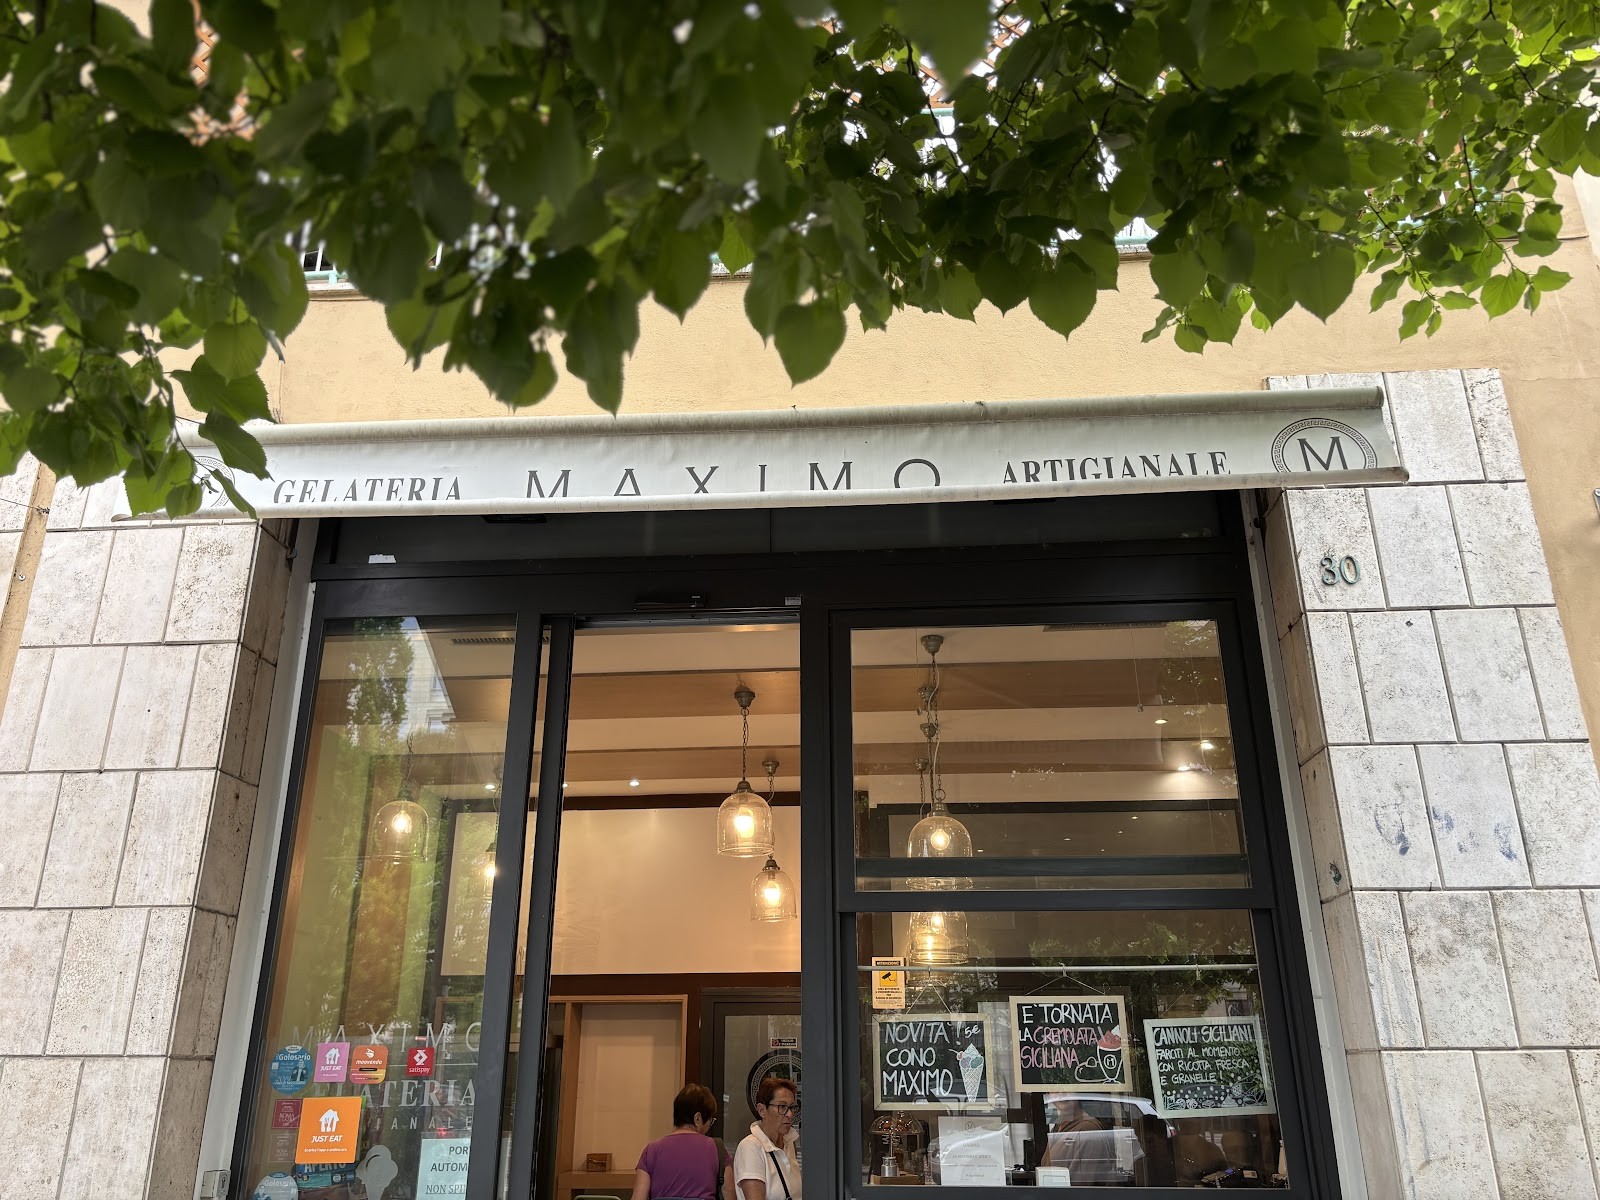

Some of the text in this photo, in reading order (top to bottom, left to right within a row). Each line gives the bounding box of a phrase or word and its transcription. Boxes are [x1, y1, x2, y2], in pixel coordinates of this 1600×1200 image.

[1296, 435, 1349, 472] M
[273, 476, 462, 504] GELATERIA
[1003, 450, 1231, 484] ARTIGIANALE
[1320, 554, 1361, 586] 30
[1038, 1003, 1113, 1024] TORNATA
[964, 1024, 981, 1039] 5€
[1019, 1027, 1033, 1042] LA
[1153, 1025, 1253, 1047] CANNOLI SICILIANI
[886, 1046, 936, 1067] CONO
[1020, 1045, 1080, 1069] SICILIANA
[1155, 1046, 1240, 1060] FARCITI AL MOMENTO
[408, 1066, 431, 1074] satispay
[1158, 1059, 1249, 1073] CON RICOTTA FRESCA
[882, 1068, 954, 1096] MAXIMO
[1160, 1076, 1168, 1086] E
[311, 1134, 343, 1143] JUST EAT
[448, 1145, 470, 1156] POR
[425, 1184, 446, 1194] NON
